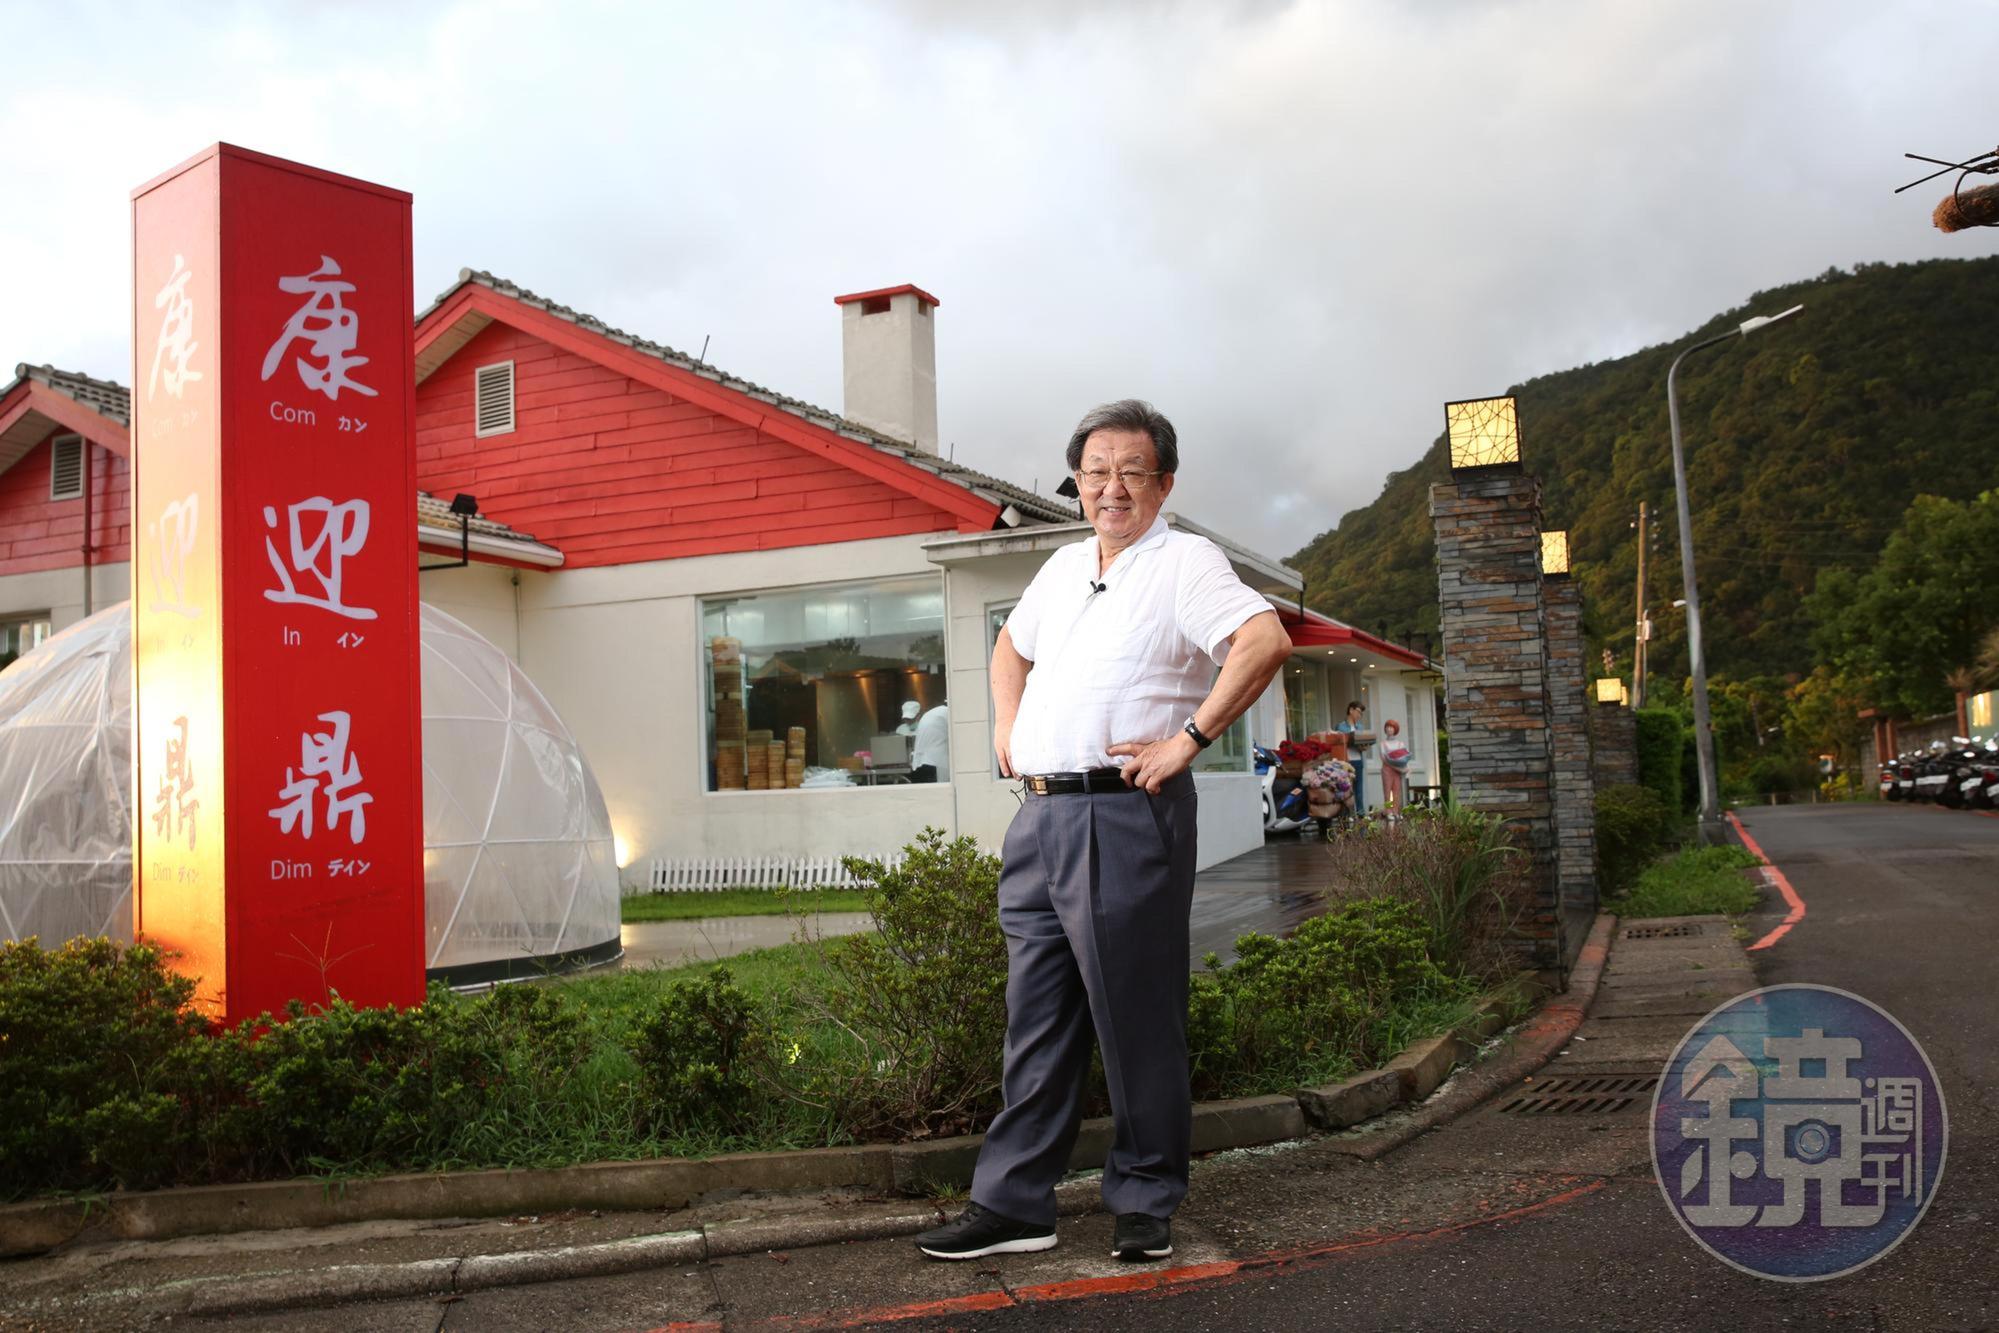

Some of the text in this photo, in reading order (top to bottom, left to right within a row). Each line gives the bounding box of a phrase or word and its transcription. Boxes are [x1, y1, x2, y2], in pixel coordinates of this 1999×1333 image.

[148, 254, 203, 401] 康
[261, 254, 380, 401] 康
[269, 401, 316, 426] Com
[337, 415, 368, 433] カン
[263, 495, 379, 620] 迎
[283, 625, 301, 646] In
[336, 631, 365, 649] イン
[151, 715, 200, 851] 鼎
[268, 710, 374, 845] 鼎
[271, 858, 312, 881] Dim
[327, 858, 371, 879] ティン
